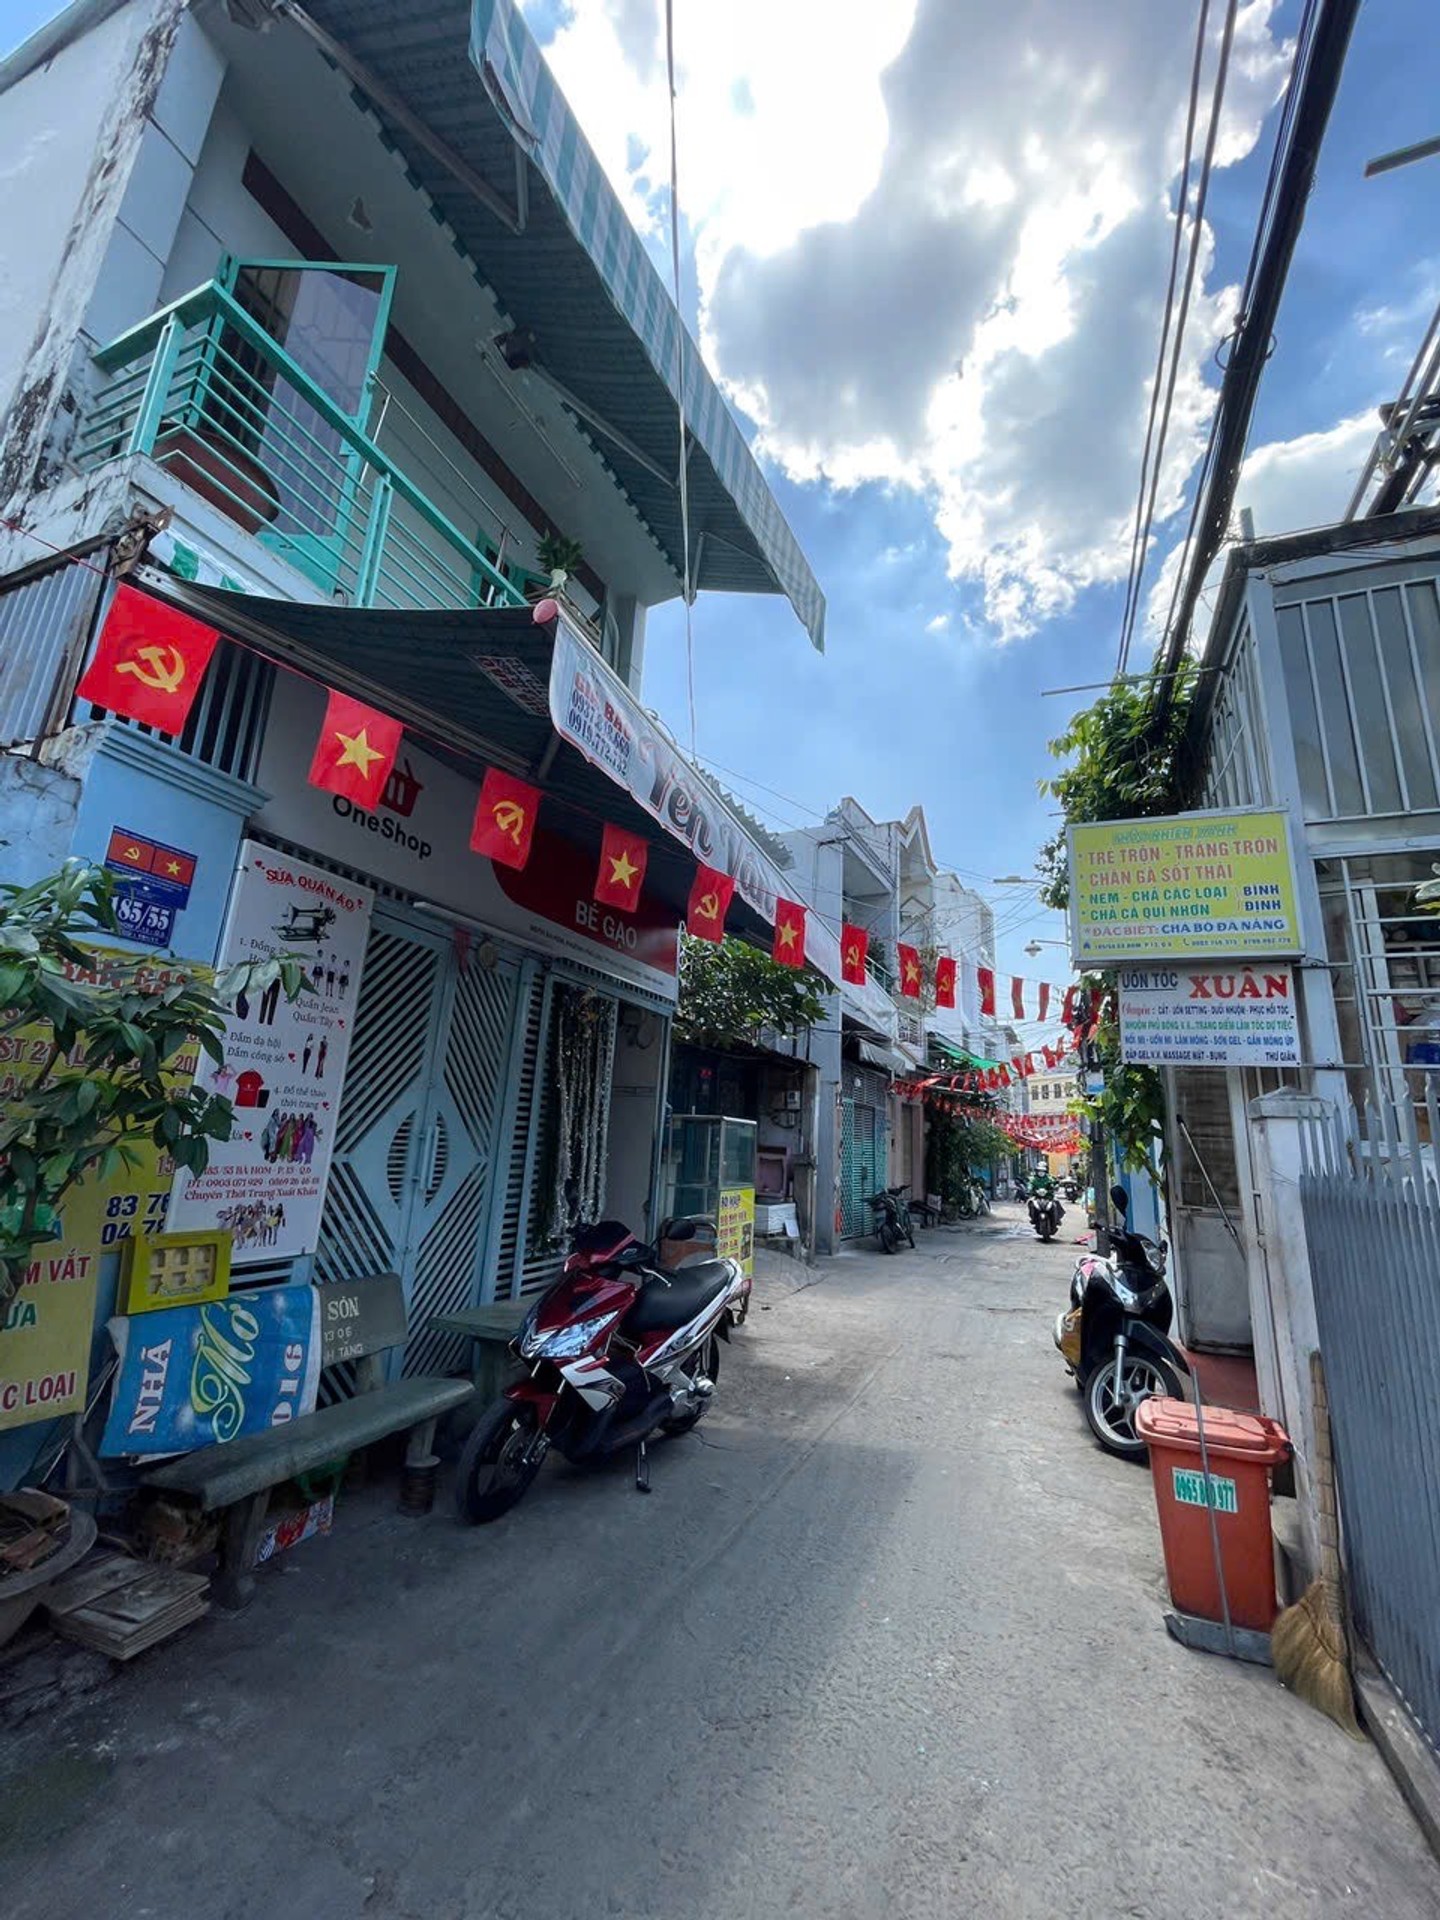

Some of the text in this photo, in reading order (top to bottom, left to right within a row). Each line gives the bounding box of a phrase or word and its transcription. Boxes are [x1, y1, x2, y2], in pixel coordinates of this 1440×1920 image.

[333, 794, 432, 860] OneShop
[1161, 862, 1190, 882] SỐT
[1089, 889, 1119, 905] NEM
[1163, 885, 1191, 902] CÁC
[1195, 886, 1228, 901] LOẠI
[575, 899, 638, 949] BÉ GẠO
[1122, 966, 1288, 999] UỐN TÓC XUÂN
[251, 1049, 273, 1063] công
[106, 1195, 138, 1217] 83
[49, 1247, 91, 1282] VẮT
[25, 1371, 76, 1405] LOẠI
[271, 1342, 303, 1427] 016
